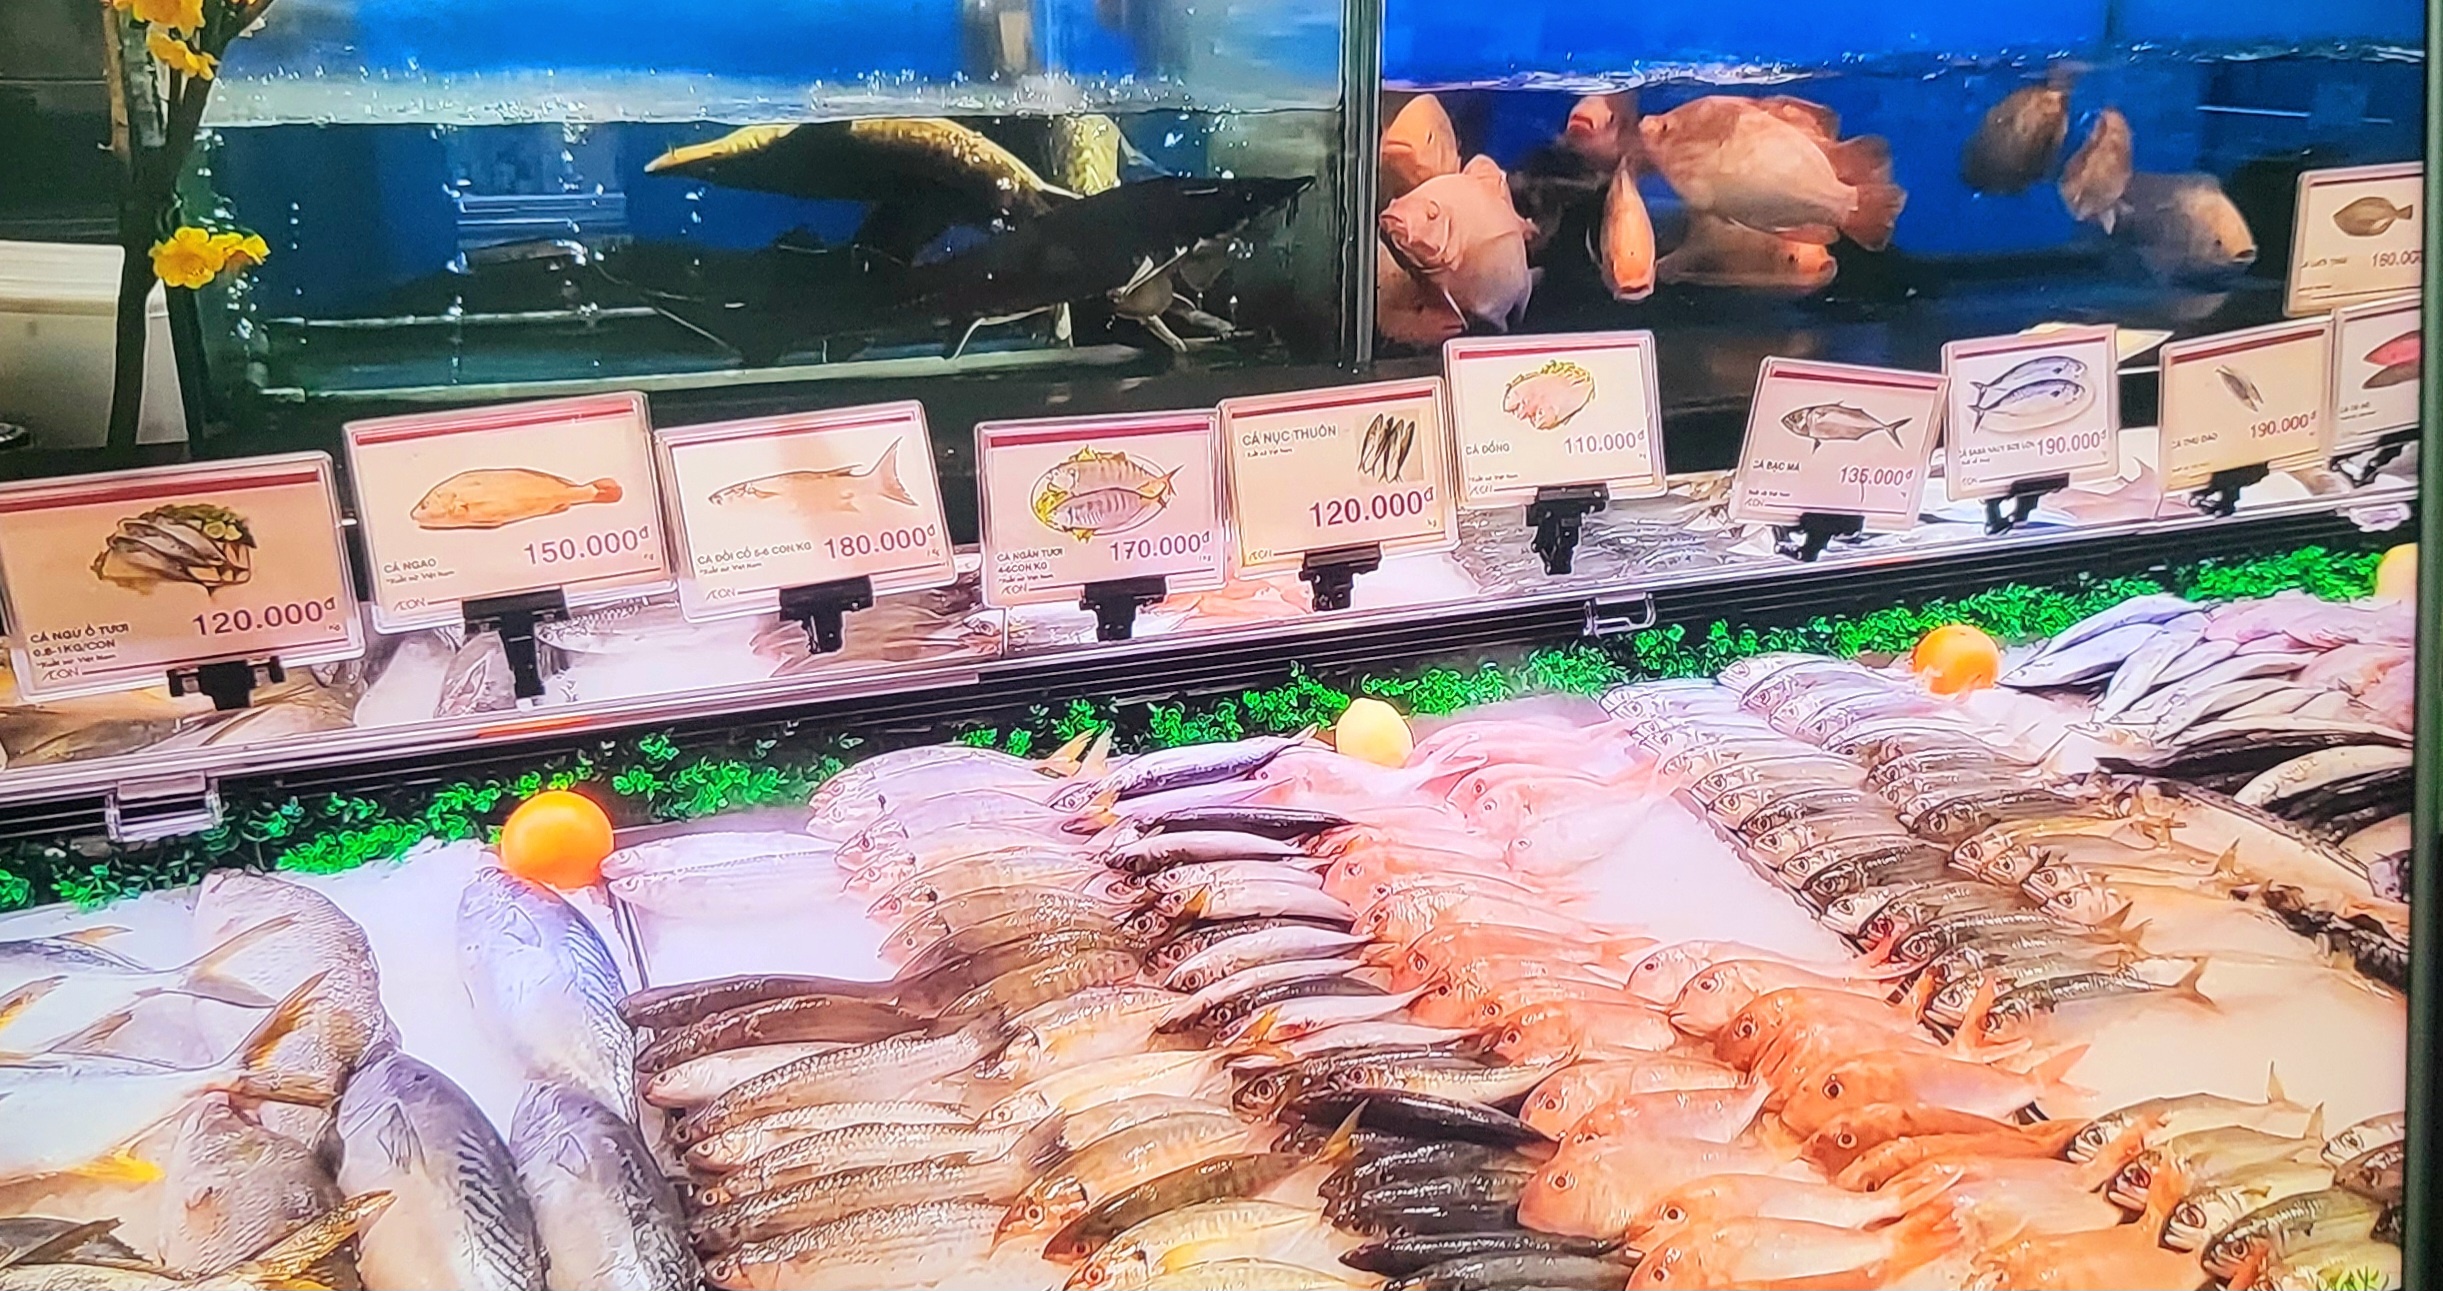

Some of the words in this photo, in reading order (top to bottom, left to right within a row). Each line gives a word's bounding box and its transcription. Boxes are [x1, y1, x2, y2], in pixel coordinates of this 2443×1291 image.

[1242, 430, 1261, 446] CÁ
[1263, 431, 1291, 445] NỤC
[1293, 424, 1337, 440] THUÔN
[402, 558, 437, 571] NGAO
